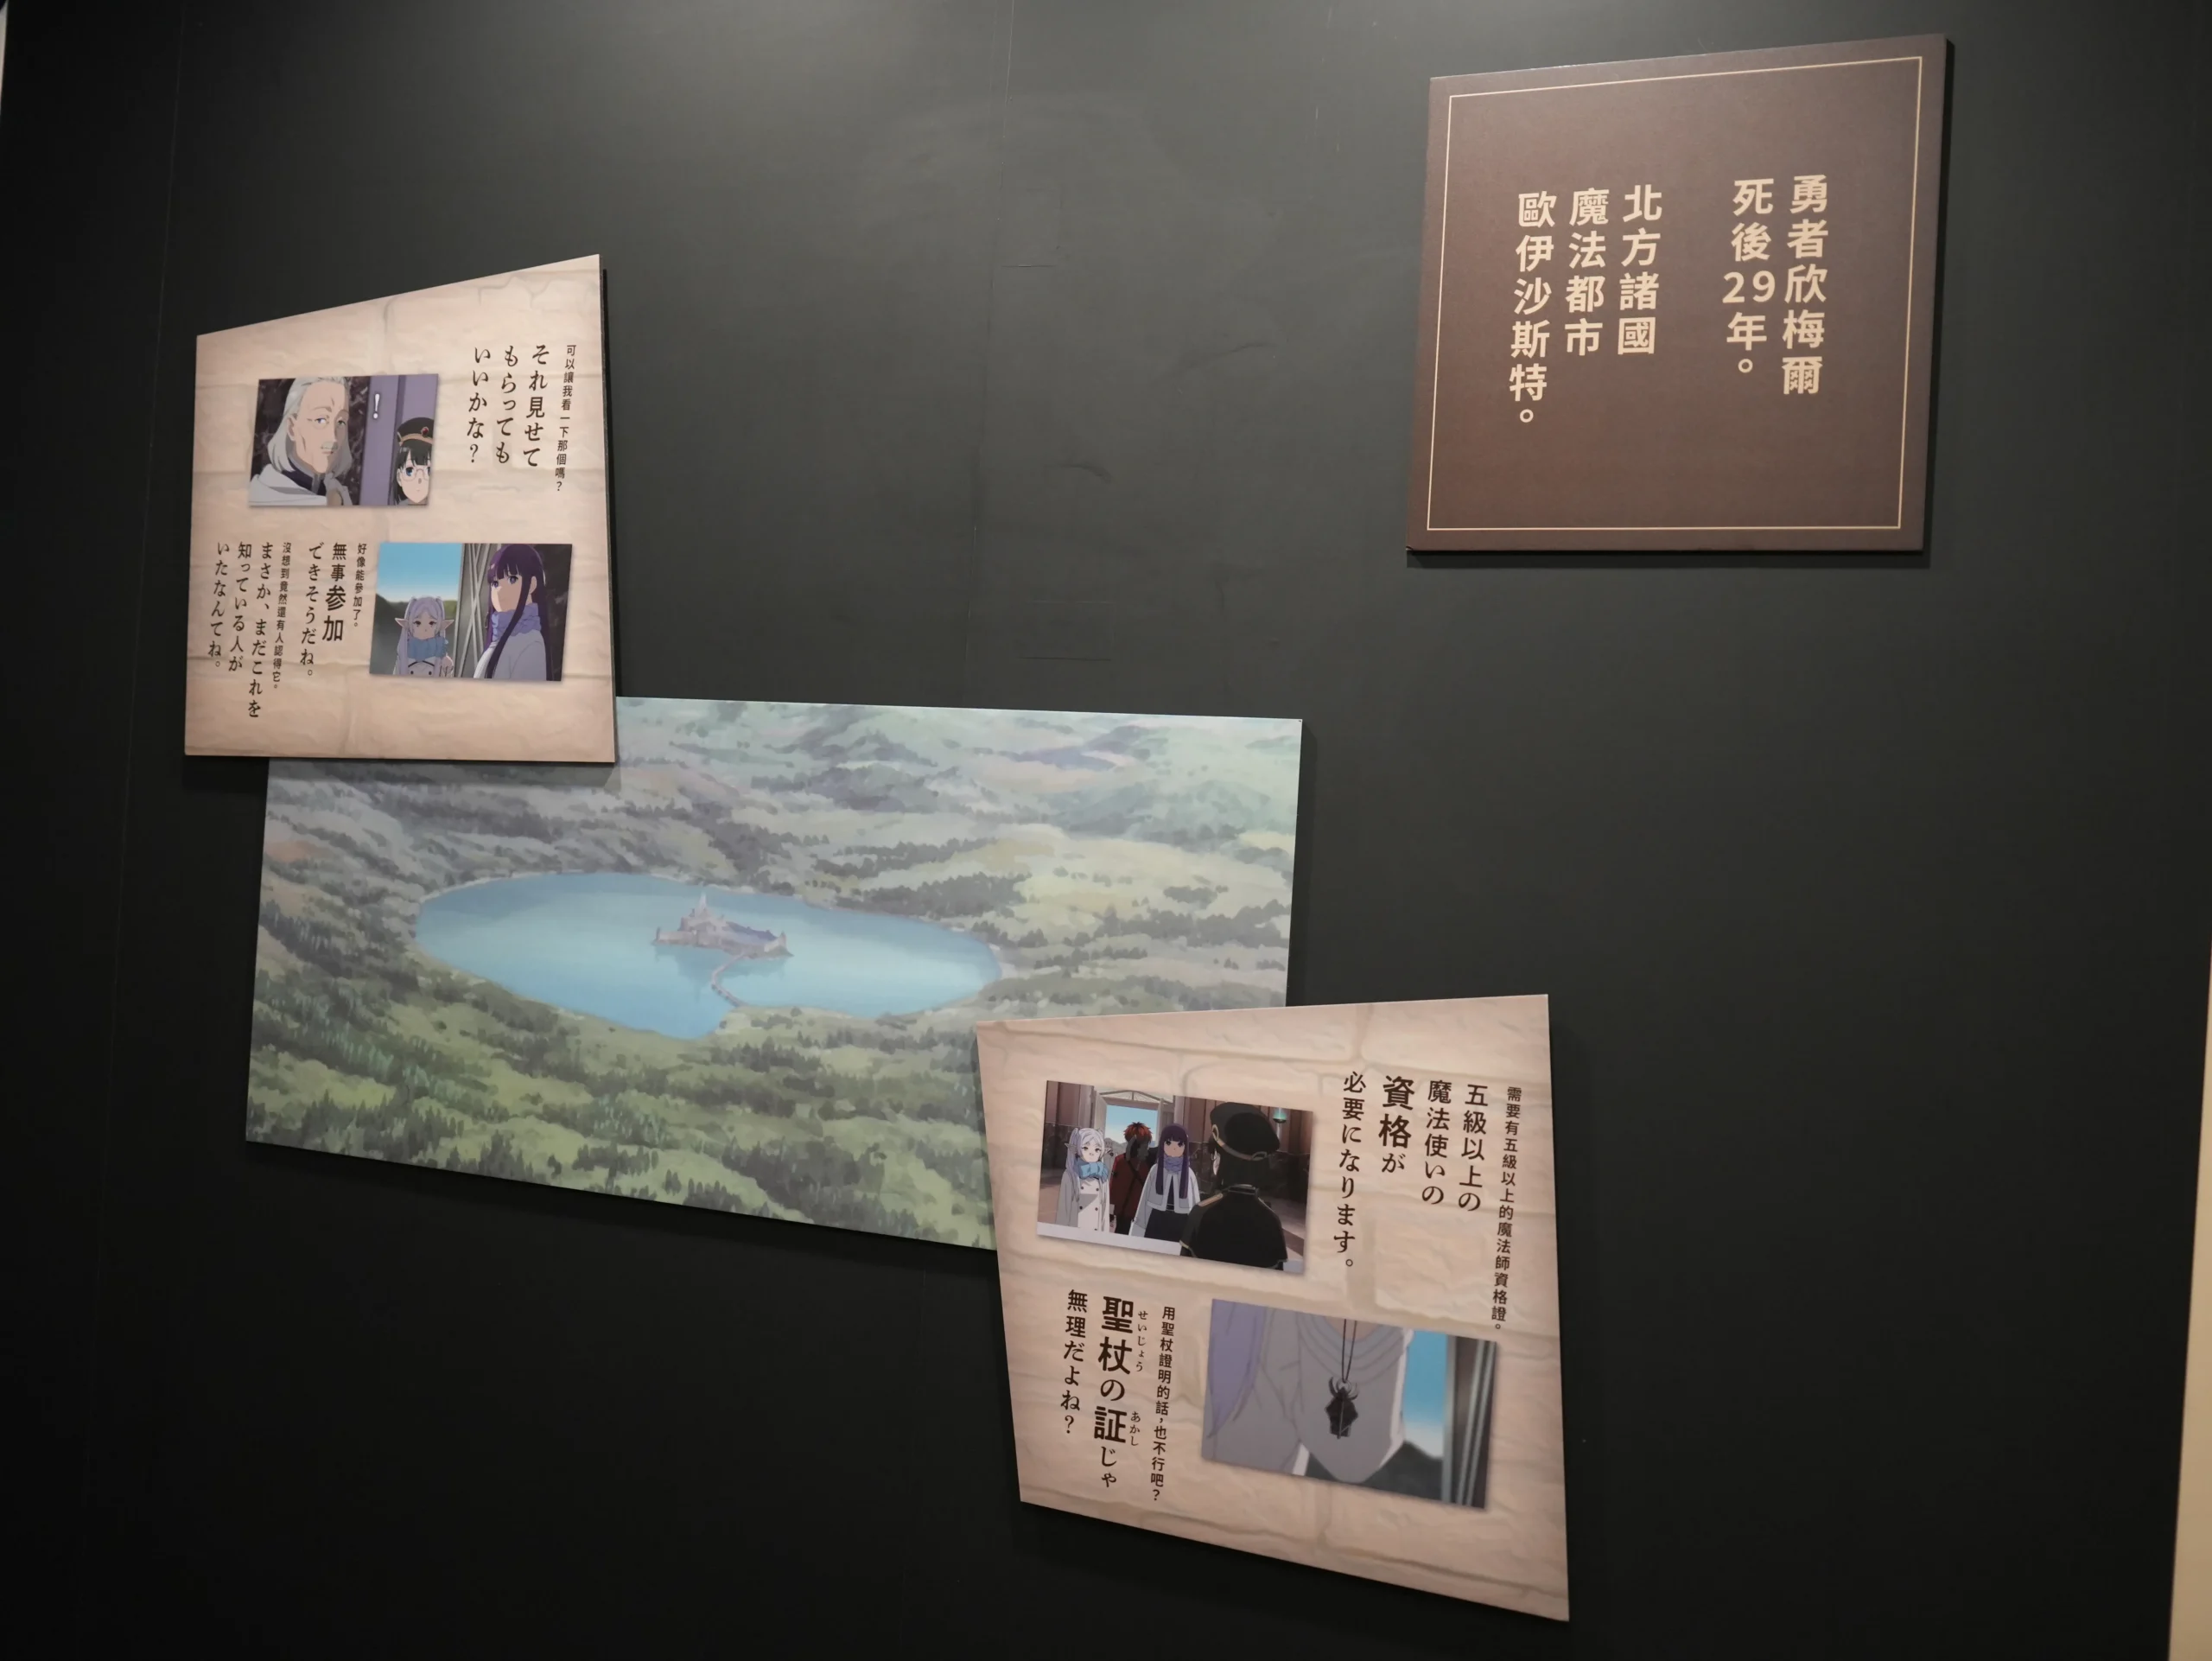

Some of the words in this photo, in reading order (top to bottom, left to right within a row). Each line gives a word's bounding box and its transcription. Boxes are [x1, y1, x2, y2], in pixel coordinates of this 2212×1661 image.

[1510, 190, 1557, 423] 歐伊沙斯特。
[1564, 188, 1609, 357] 魔法都市
[1618, 184, 1662, 355] 北方諸國
[1722, 177, 1776, 374] 死後29年。
[1782, 174, 1830, 395] 勇者欣梅爾
[467, 347, 491, 463] いいかな？
[496, 346, 518, 463] もらっても
[523, 345, 550, 467] それ見せて
[555, 345, 576, 491] 可以讓我看一下那個嗎？
[208, 542, 230, 667] いたなんてね。
[228, 542, 251, 671] 知っている人が
[248, 542, 274, 717] まさか、まだこれを
[272, 542, 291, 689] 沒想到竟然還有人認得它。
[300, 542, 324, 676] できそうだね。
[321, 543, 347, 641] 無事参加
[353, 543, 367, 627] 好像能參加了。
[1333, 1071, 1366, 1267] 必要になります。
[1378, 1075, 1414, 1174] 資格が
[1421, 1080, 1452, 1205] 魔法使いの
[1458, 1083, 1488, 1212] 五級以上の
[1491, 1086, 1522, 1329] 需要有五級以上的魔法師資格證。
[1060, 1289, 1088, 1434] 無理だよね？
[1094, 1296, 1134, 1488] 聖杖の証じゃ
[1135, 1310, 1148, 1372] せいじょう
[1129, 1410, 1141, 1447] あかし
